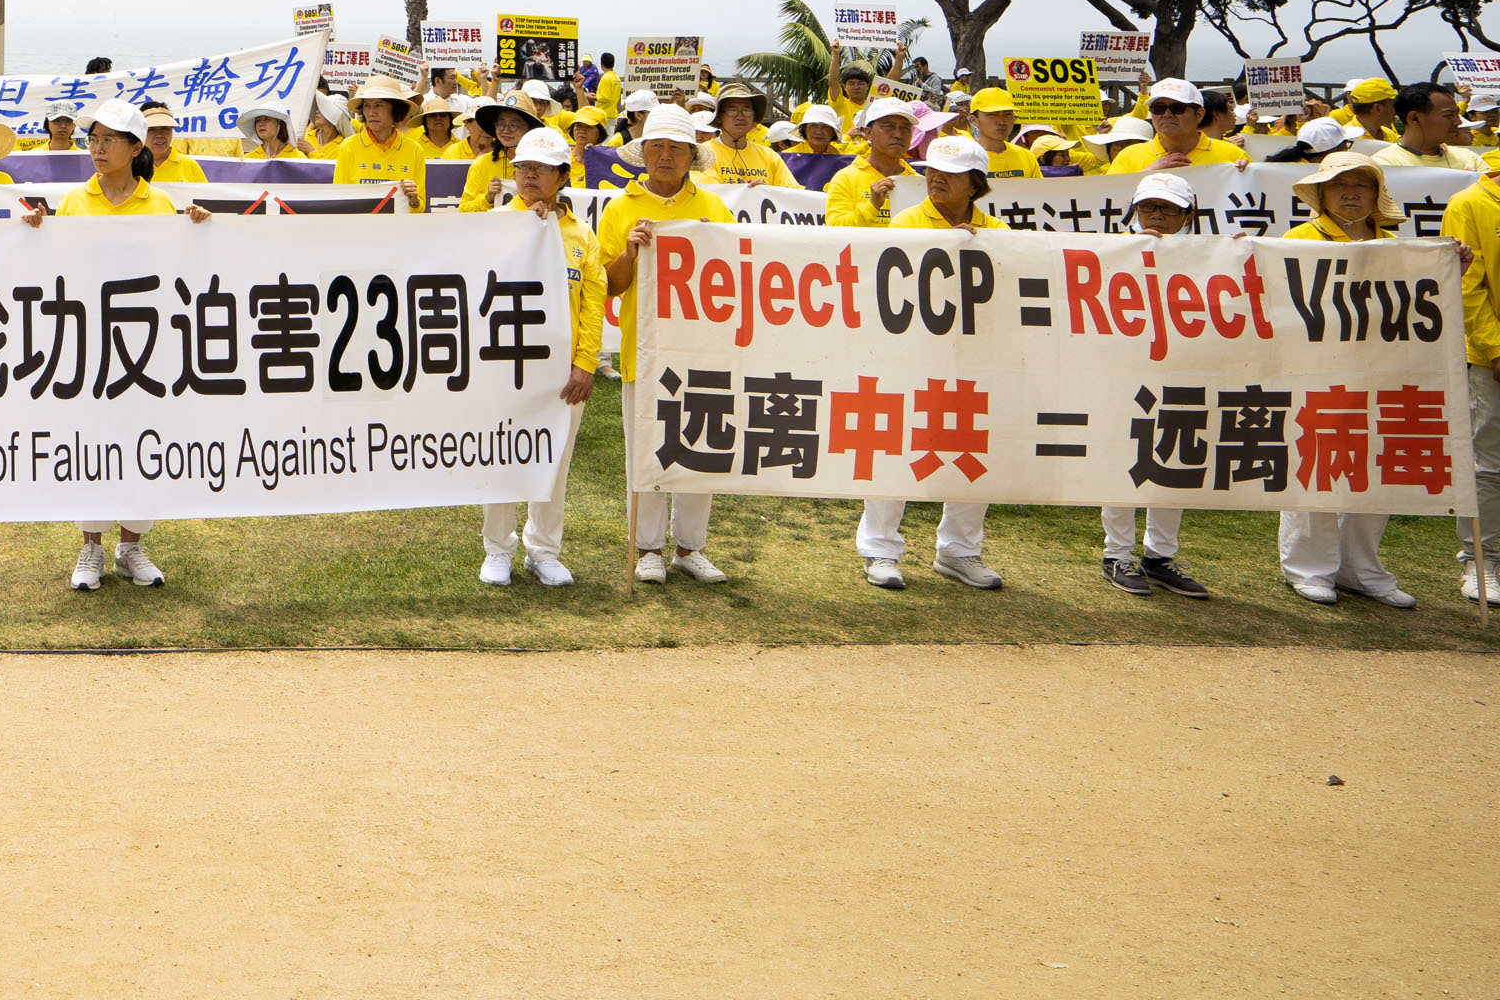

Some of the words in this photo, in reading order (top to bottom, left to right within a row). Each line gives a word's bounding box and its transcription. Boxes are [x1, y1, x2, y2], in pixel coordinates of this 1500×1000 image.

[305, 9, 317, 17] SOS!
[835, 9, 896, 24] 法辦江澤民
[423, 27, 482, 42] 法辦江澤民
[1081, 34, 1149, 51] 法辦江澤民
[391, 42, 407, 53] SOS!
[648, 43, 671, 55] SOS!
[323, 50, 369, 65] 辦江澤民
[500, 39, 516, 74] SOS!
[1032, 59, 1095, 84] SOS!
[1247, 66, 1302, 85] 法辦江澤民
[721, 167, 745, 176] FALUN
[746, 167, 768, 177] GONG
[656, 235, 861, 348] Reject
[876, 246, 995, 336] CCP
[1063, 248, 1274, 361] Reject
[1284, 257, 1443, 343] Virus
[655, 366, 989, 484] 远离中共
[1128, 384, 1452, 495] 远离病毒
[32, 429, 123, 482] Falun
[136, 428, 226, 493] Gong
[235, 425, 357, 491] Against
[367, 418, 553, 472] Persecution
